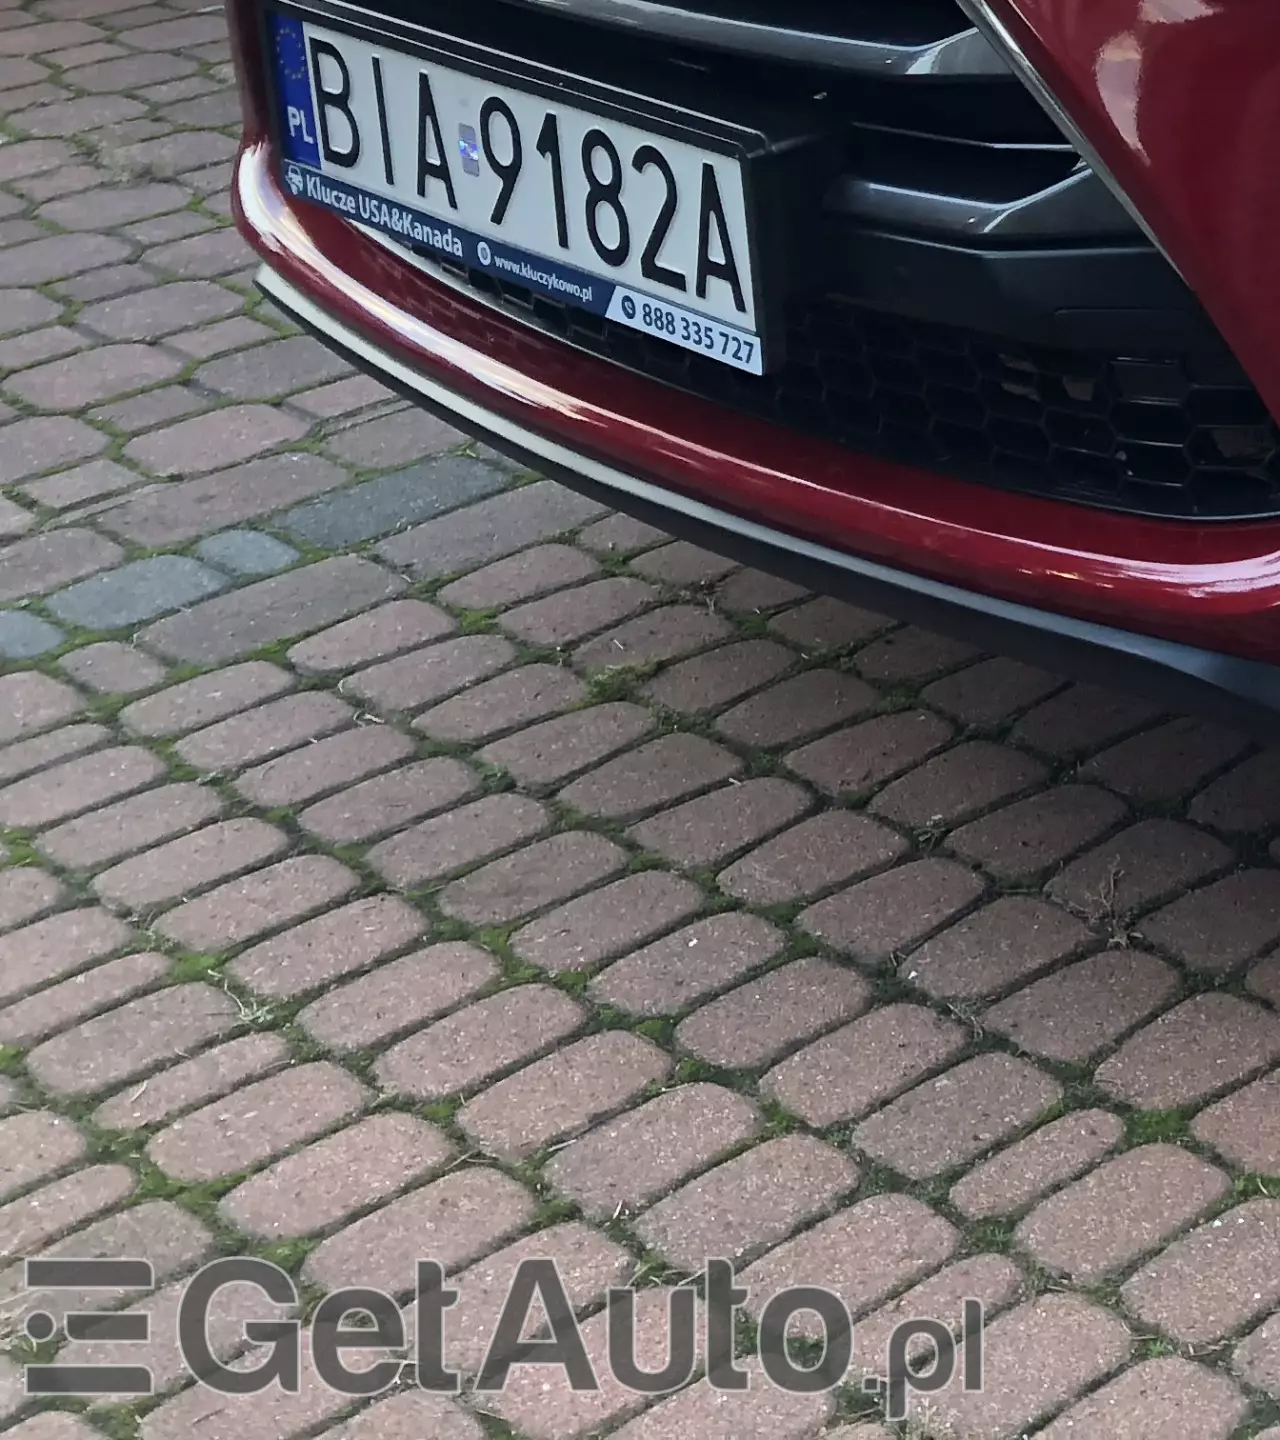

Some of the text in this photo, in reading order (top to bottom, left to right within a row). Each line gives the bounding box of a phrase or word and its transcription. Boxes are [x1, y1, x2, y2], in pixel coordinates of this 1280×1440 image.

[287, 105, 314, 145] PL
[308, 36, 748, 313] BIA 9182A
[305, 174, 464, 258] Klucze USA&Kanada
[642, 303, 755, 365] 888 335 727
